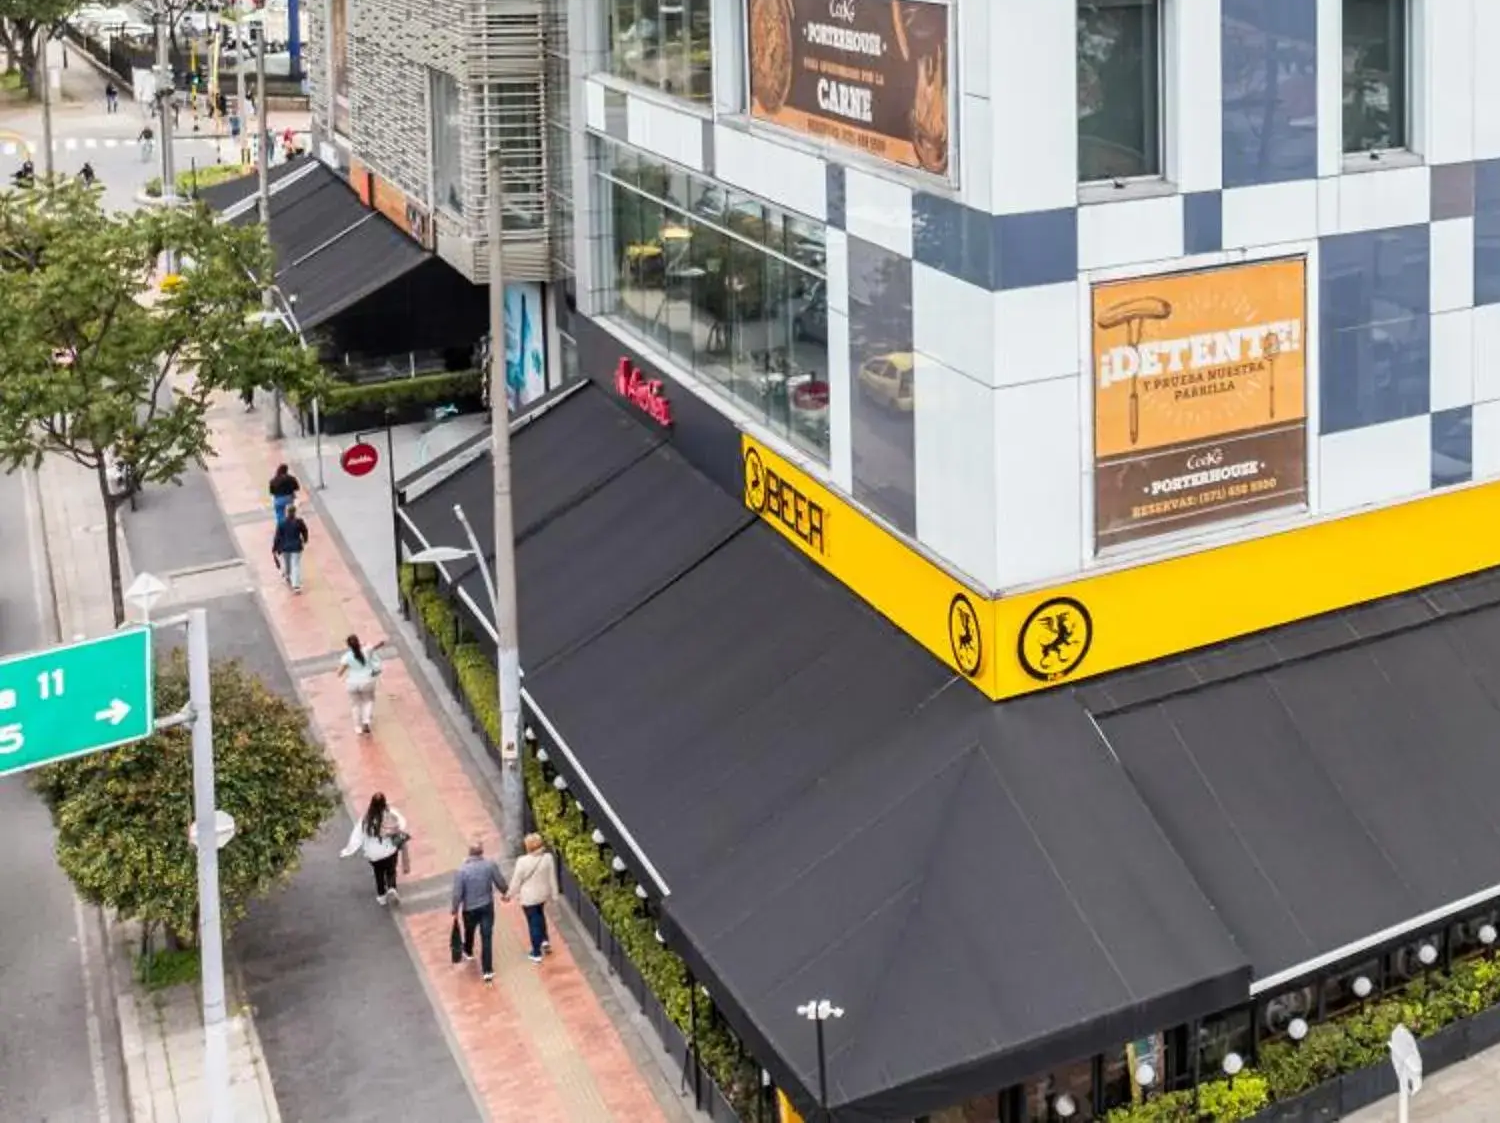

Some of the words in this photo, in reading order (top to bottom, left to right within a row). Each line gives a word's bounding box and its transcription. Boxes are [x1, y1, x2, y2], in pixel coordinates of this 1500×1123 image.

[807, 22, 883, 57] PORTERHOUSE
[817, 77, 873, 123] CARNE
[1153, 371, 1204, 392] PRUEBA
[1207, 361, 1266, 383] NUESTRA
[1174, 380, 1236, 401] PARRILLA
[1151, 459, 1260, 496] PORTERHOUSE
[36, 667, 65, 700] 11
